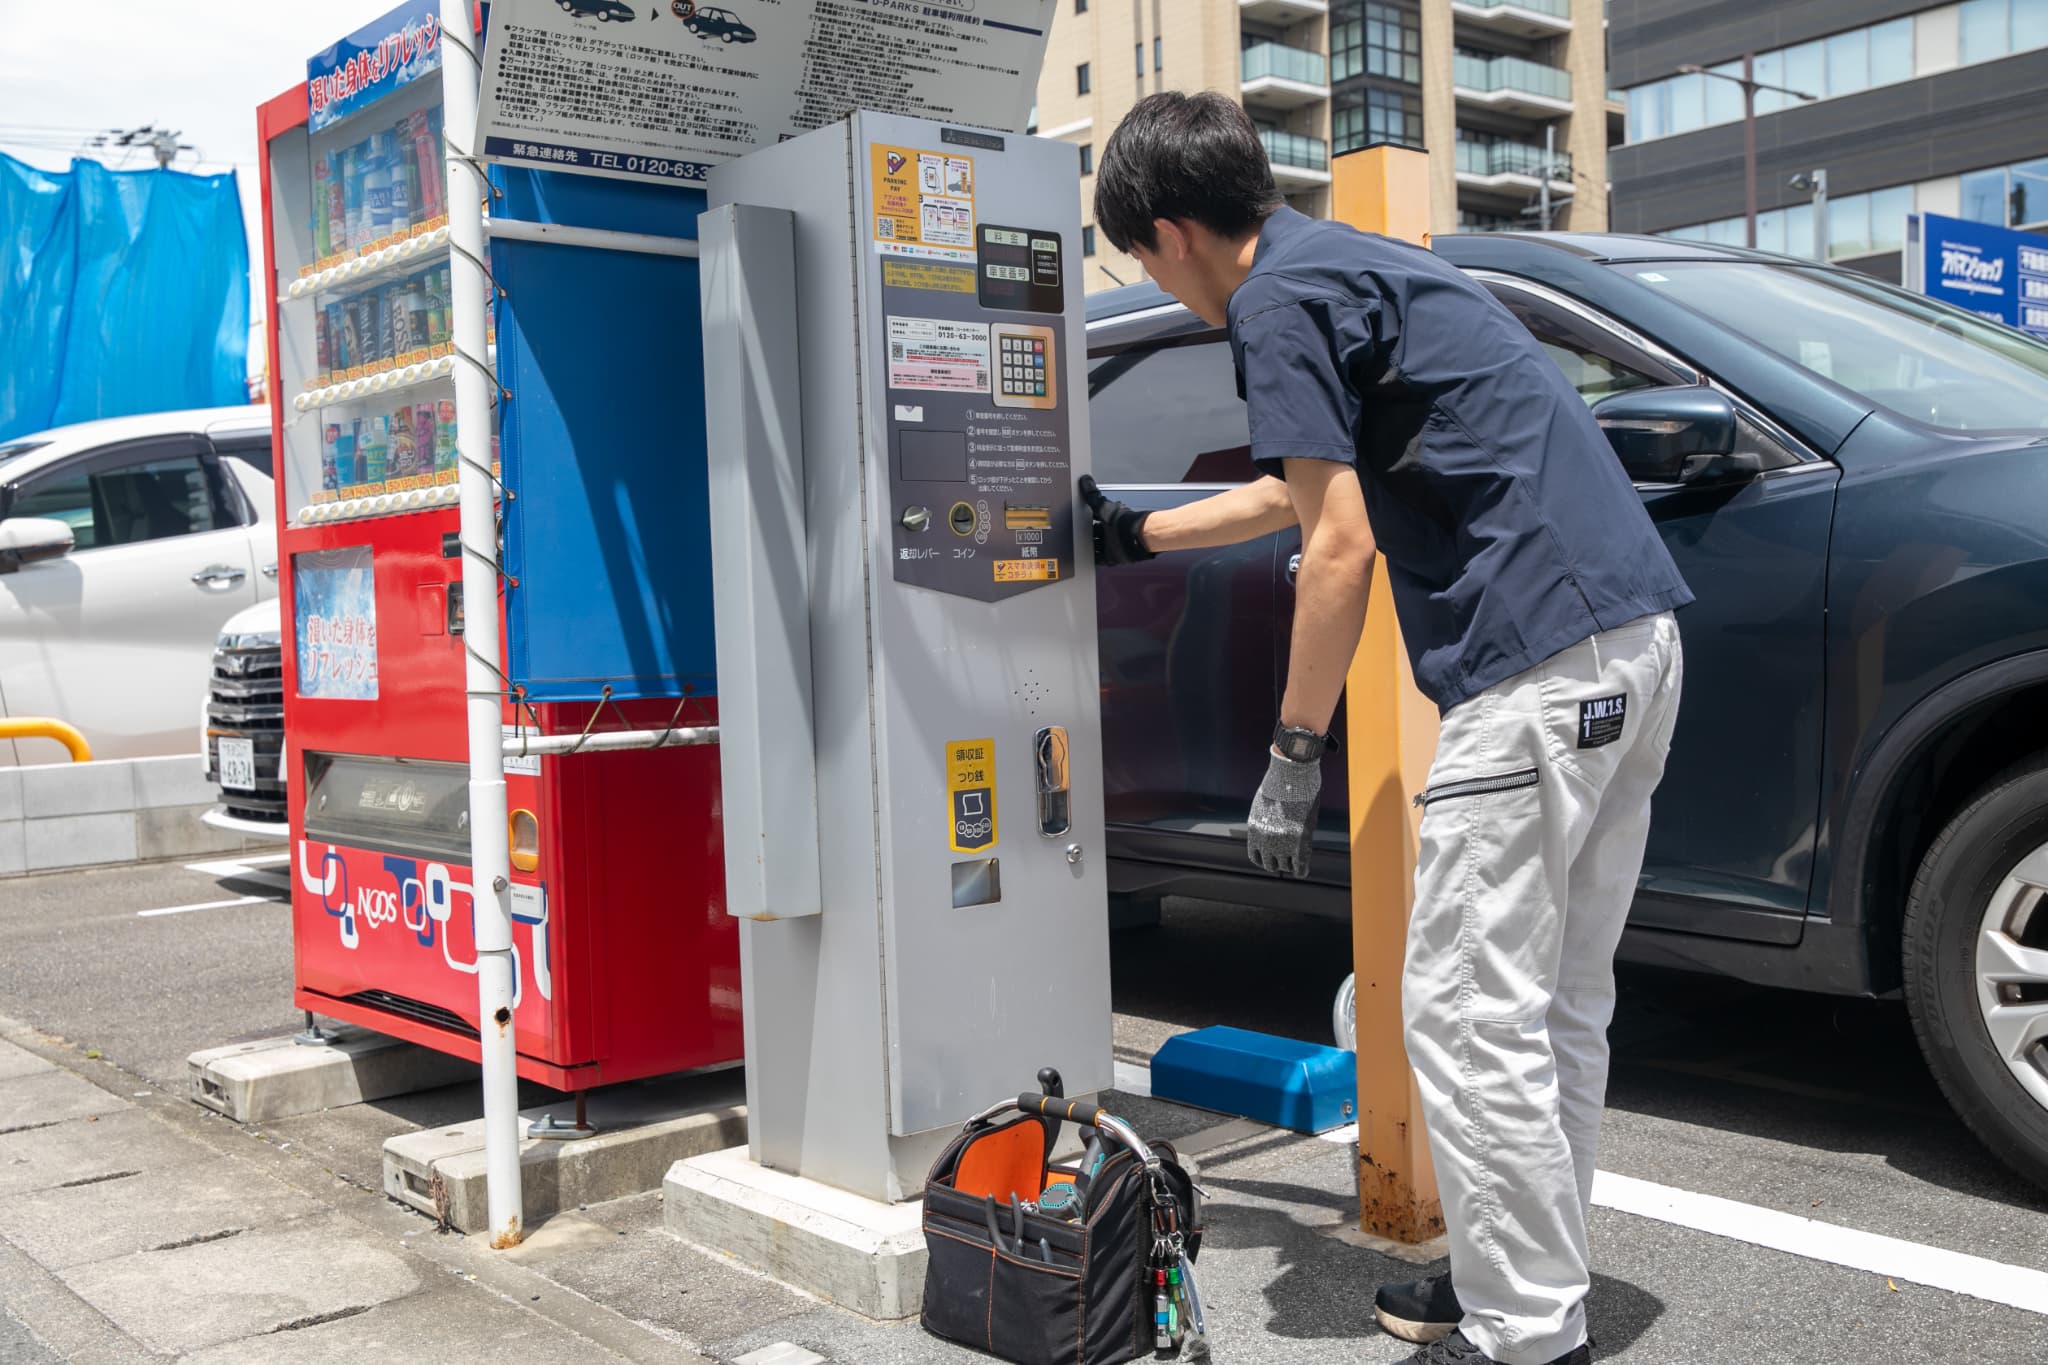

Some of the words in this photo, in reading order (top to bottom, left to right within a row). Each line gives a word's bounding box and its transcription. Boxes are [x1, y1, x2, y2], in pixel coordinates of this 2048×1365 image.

[512, 143, 578, 162] 緊急連絡先
[590, 152, 623, 169] TEL
[883, 177, 907, 185] PARKING
[989, 266, 1026, 280] 車室番号
[393, 303, 411, 353] BOSS
[899, 549, 941, 560] 返却レバー
[953, 548, 976, 558] コイン
[1021, 546, 1038, 558] 紙幣
[306, 649, 378, 682] リフレッシュ
[956, 747, 985, 762] 領収証
[958, 770, 985, 783] つり銭
